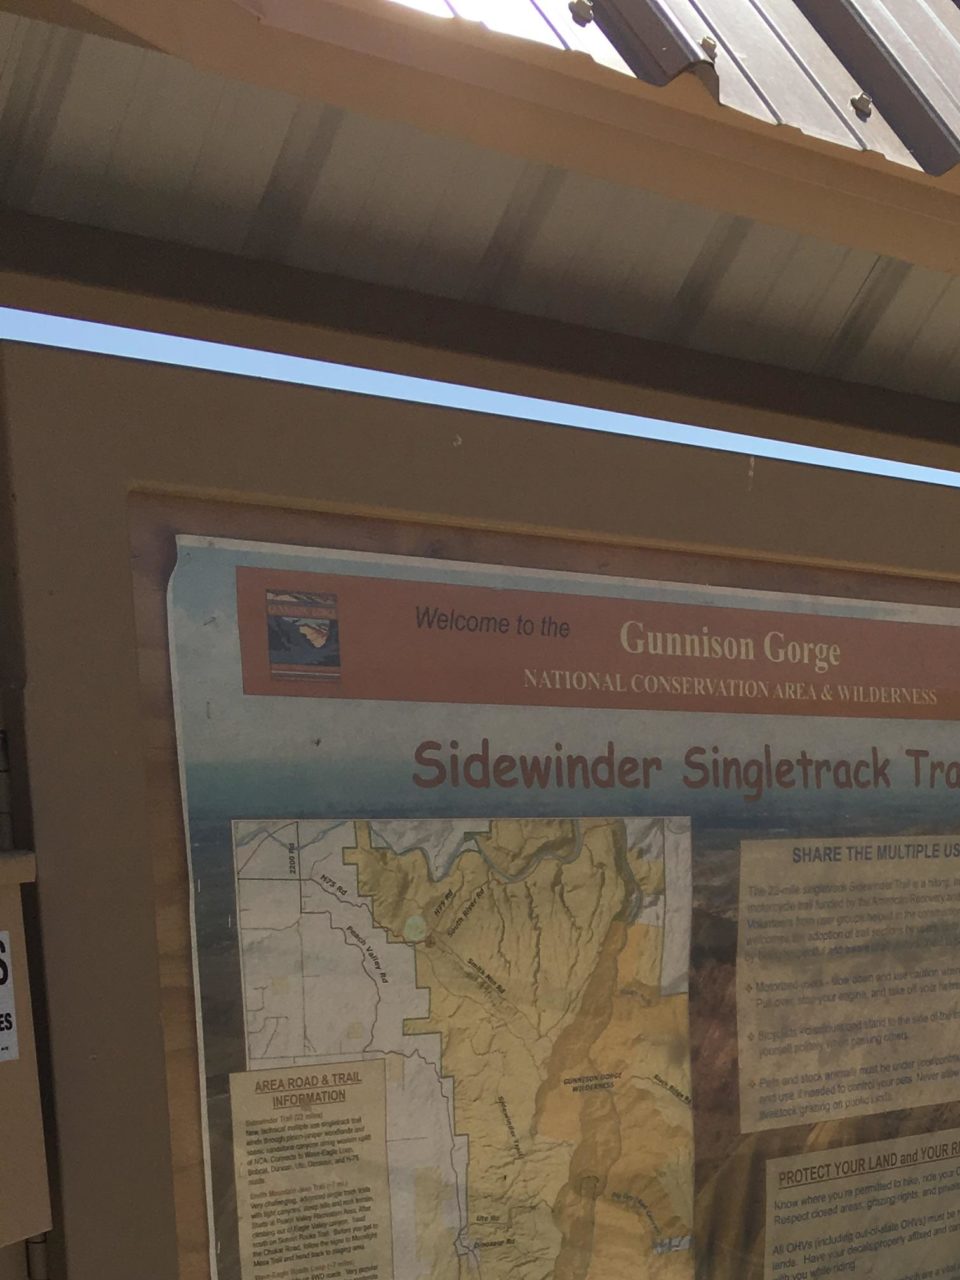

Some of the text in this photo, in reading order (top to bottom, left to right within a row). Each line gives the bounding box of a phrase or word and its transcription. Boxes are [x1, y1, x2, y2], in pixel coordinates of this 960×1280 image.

[415, 606, 841, 674] Welcome to the Gunnison Gorge
[524, 669, 938, 706] NATIONAL CONSERVATION AREA & WILDERNESS
[413, 738, 662, 791] Sidewinder
[683, 743, 891, 800] Singletrack
[792, 845, 841, 863] SHARE
[847, 844, 872, 861] THE
[877, 842, 940, 860] MULTIPLE
[365, 945, 382, 970] Valley
[254, 1071, 361, 1091] AREA ROAD & TRAIL
[272, 1089, 345, 1107] INFORMATION
[778, 1162, 831, 1186] PROTECT
[834, 1156, 864, 1176] YOUR
[868, 1150, 897, 1170] LAND
[900, 1147, 917, 1164] and
[921, 1141, 948, 1160] YOUR
[774, 1209, 809, 1227] Respect
